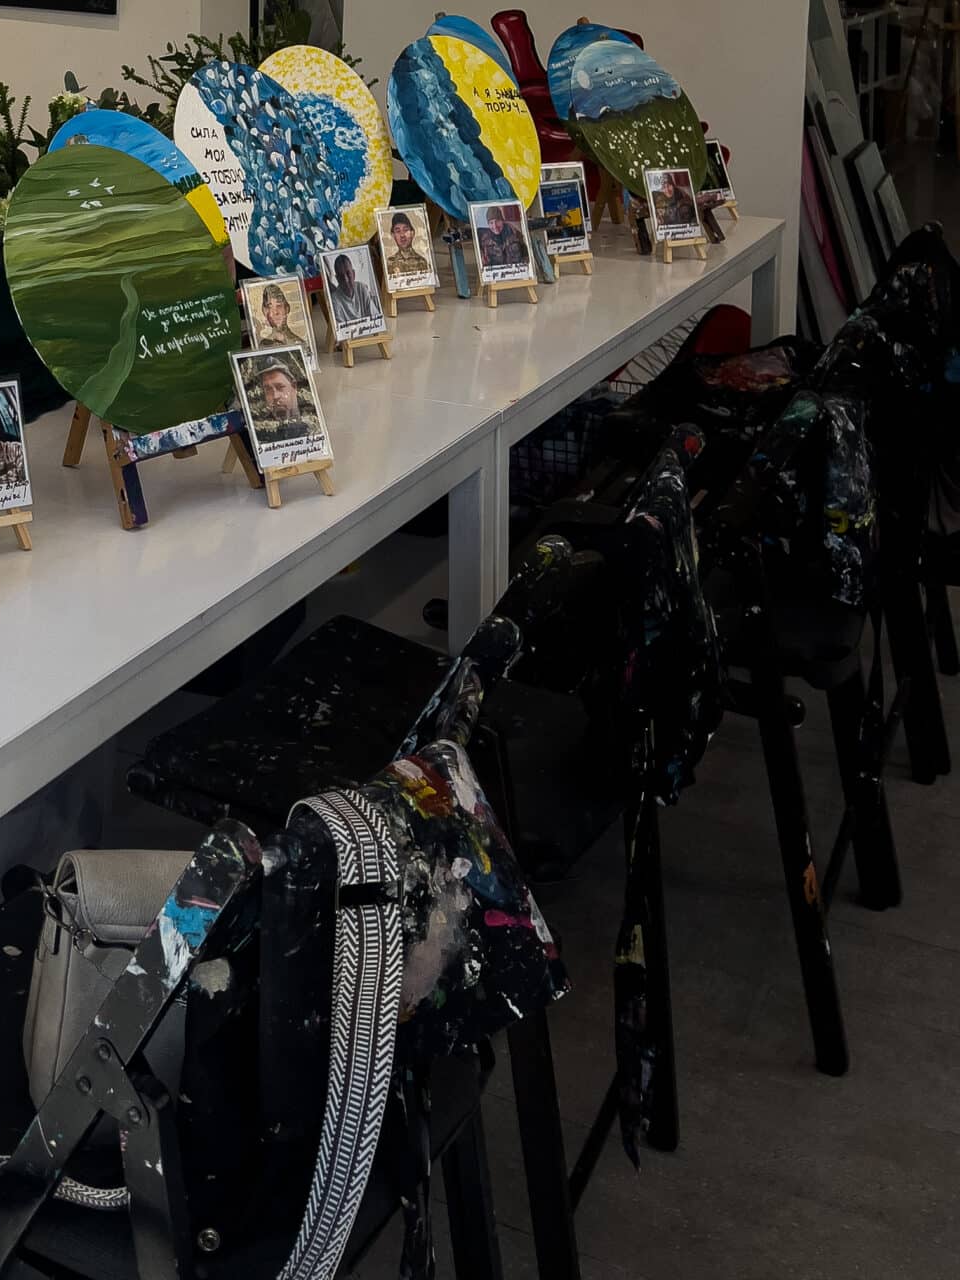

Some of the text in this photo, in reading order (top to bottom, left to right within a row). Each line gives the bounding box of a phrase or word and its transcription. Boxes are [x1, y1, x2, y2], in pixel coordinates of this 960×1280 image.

[190, 127, 219, 140] СИЛА
[204, 148, 226, 162] МОЯ
[202, 167, 246, 185] З ТОБОЮ
[138, 334, 153, 359] Я
[154, 342, 167, 355] не
